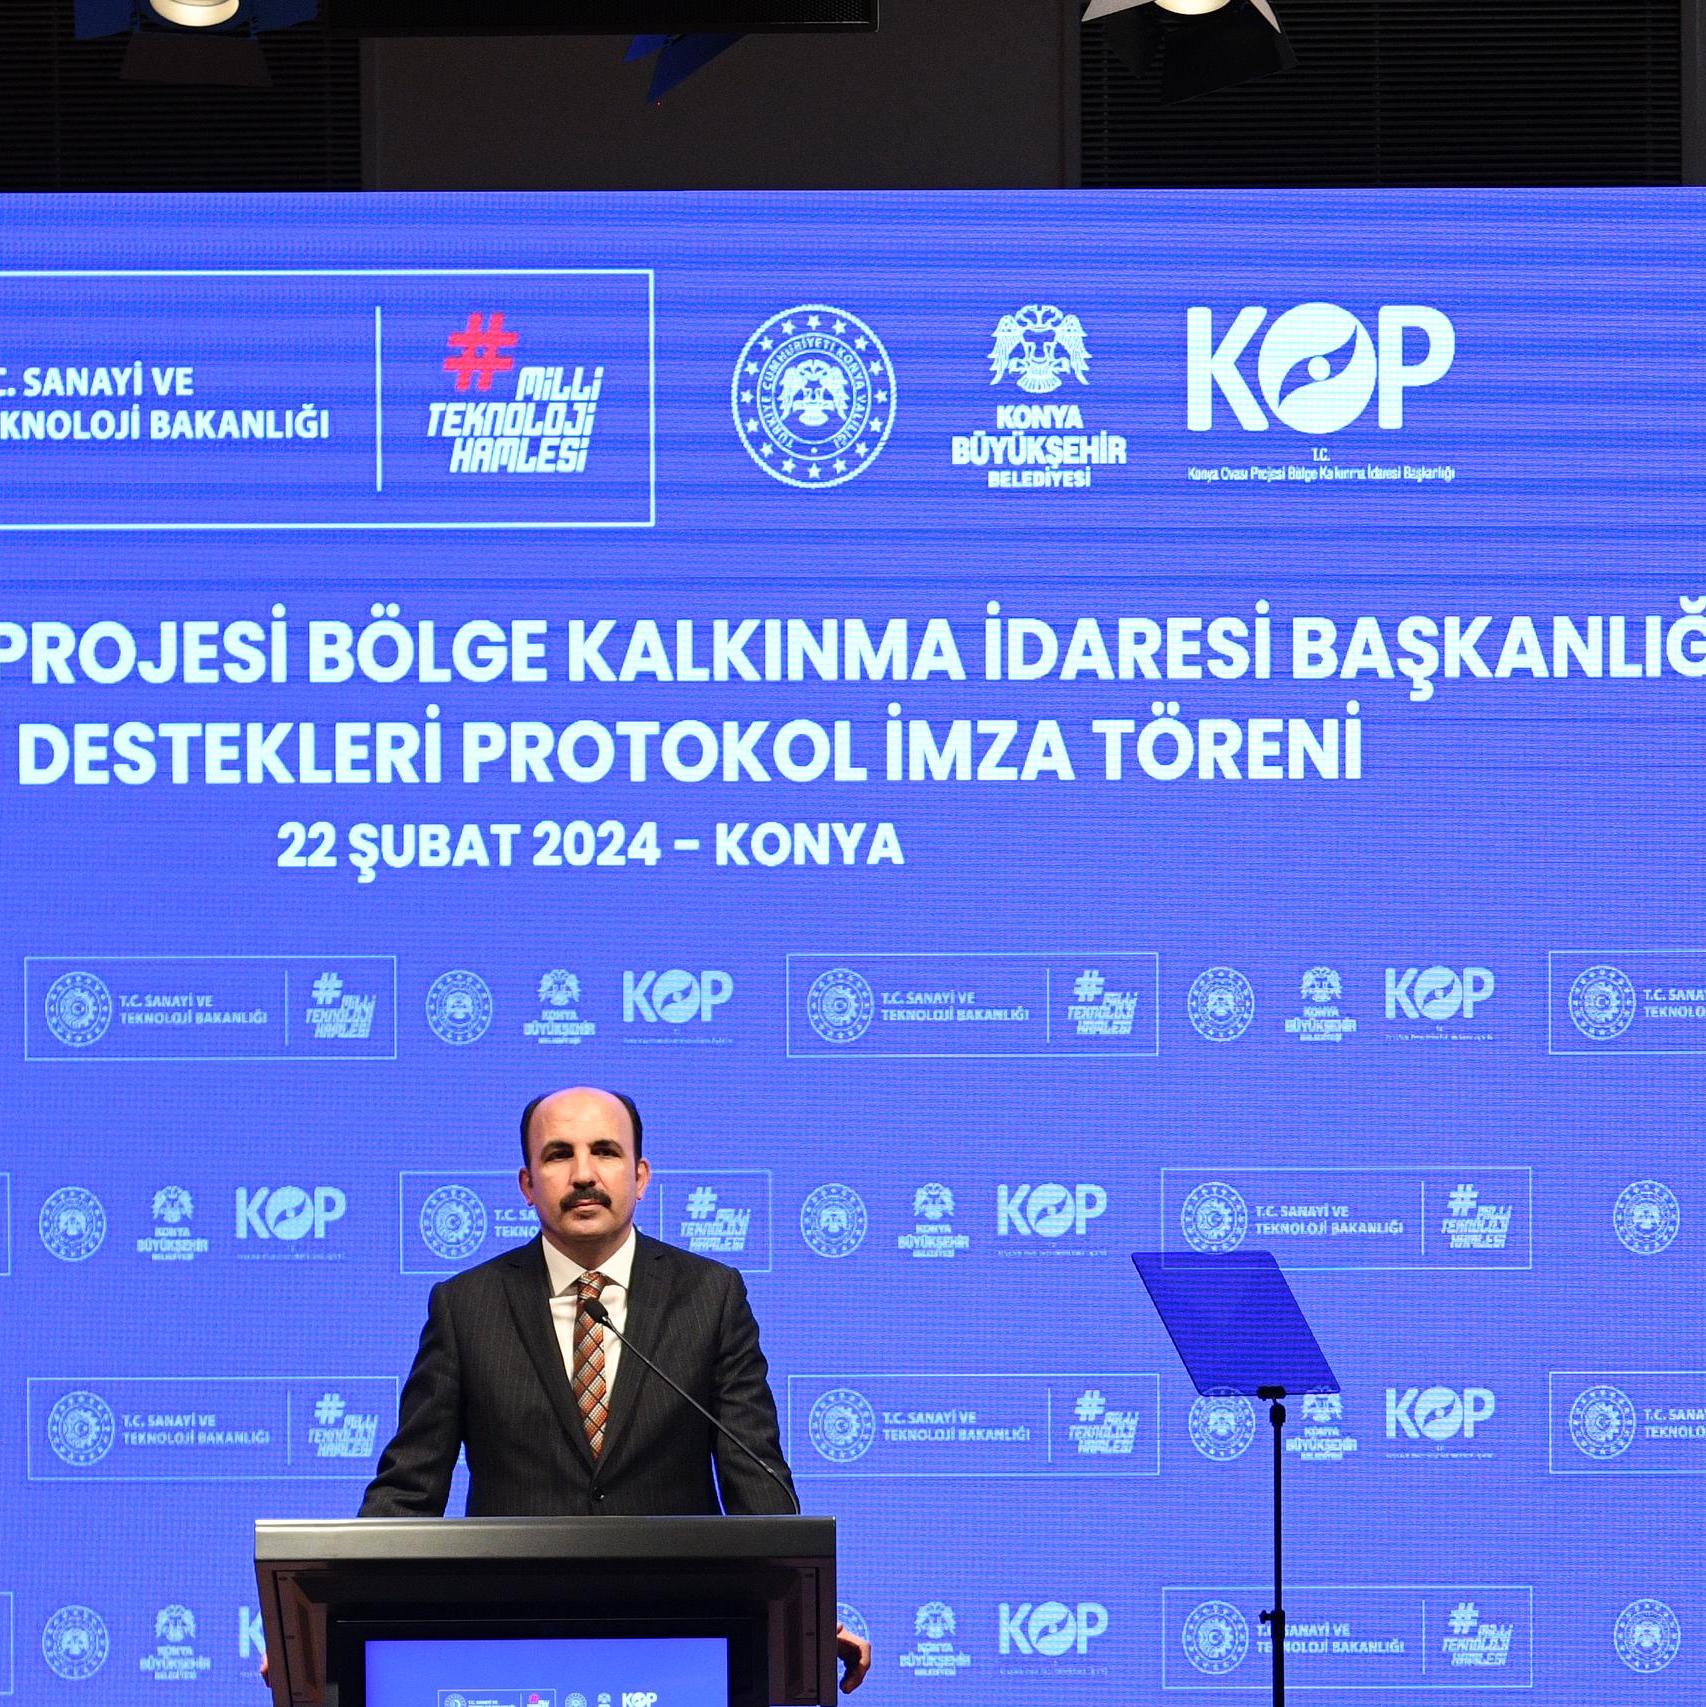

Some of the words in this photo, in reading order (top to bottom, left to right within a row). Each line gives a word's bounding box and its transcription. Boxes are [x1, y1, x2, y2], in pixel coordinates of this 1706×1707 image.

[24, 361, 143, 397] SANAYİ
[151, 367, 194, 396] VE
[1187, 302, 1455, 434] KOP
[150, 402, 330, 440] BAKANLIĞI
[996, 405, 1083, 430] KONYA
[951, 430, 1127, 468] BÜYÜKŞEHİR
[988, 466, 1091, 488] BELEDİYESİ
[308, 602, 548, 683] BÖLGE
[568, 618, 967, 682] KALKINMA
[986, 598, 1271, 681] İDARESİ
[18, 704, 442, 785] DESTEKLERİ
[462, 718, 868, 783] PROTOKOL
[886, 702, 1076, 782] İMZA
[1091, 700, 1362, 781] TÖRENİ
[278, 822, 337, 867] 22
[348, 822, 522, 884] ŞUBAT
[533, 820, 662, 867] 2024
[715, 821, 905, 867] KONYA
[119, 995, 142, 1007] T.C.
[145, 993, 193, 1007] SANAYİ
[197, 996, 213, 1007] VE
[623, 969, 733, 1023] KOP
[881, 992, 904, 1004] T.C.
[906, 990, 955, 1004] SANAYİ
[958, 992, 974, 1004] VE
[1385, 966, 1494, 1020] KOP
[1643, 988, 1666, 1000] T.C.
[121, 1009, 192, 1024] TEKNOLOJİ
[195, 1009, 267, 1024] BAKANLIĞI
[881, 1006, 954, 1021] TEKNOLOJİ
[957, 1005, 1029, 1021] BAKANLIĞI
[236, 1186, 346, 1240] KOP
[997, 1183, 1107, 1237] KOP
[1256, 1205, 1278, 1217] T.C.
[1281, 1203, 1329, 1217] SANAYİ
[1332, 1206, 1348, 1217] VE
[1256, 1220, 1327, 1235] TEKNOLOJİ
[1331, 1219, 1403, 1235] BAKANLIĞI
[122, 1415, 145, 1427] T.C.
[148, 1412, 195, 1428] SANAYİ
[199, 1415, 215, 1427] VE
[882, 1412, 906, 1424] T.C.
[908, 1409, 956, 1424] SANAYİ
[959, 1412, 976, 1424] VE
[1386, 1387, 1495, 1440] KOP
[1644, 1409, 1666, 1420] T.C.
[123, 1430, 194, 1445] TEKNOLOJİ
[198, 1430, 270, 1444] BAKANLIĞI
[883, 1427, 955, 1441] TEKNOLOJİ
[958, 1426, 1030, 1441] BAKANLIĞI
[999, 1602, 1108, 1655] KOP
